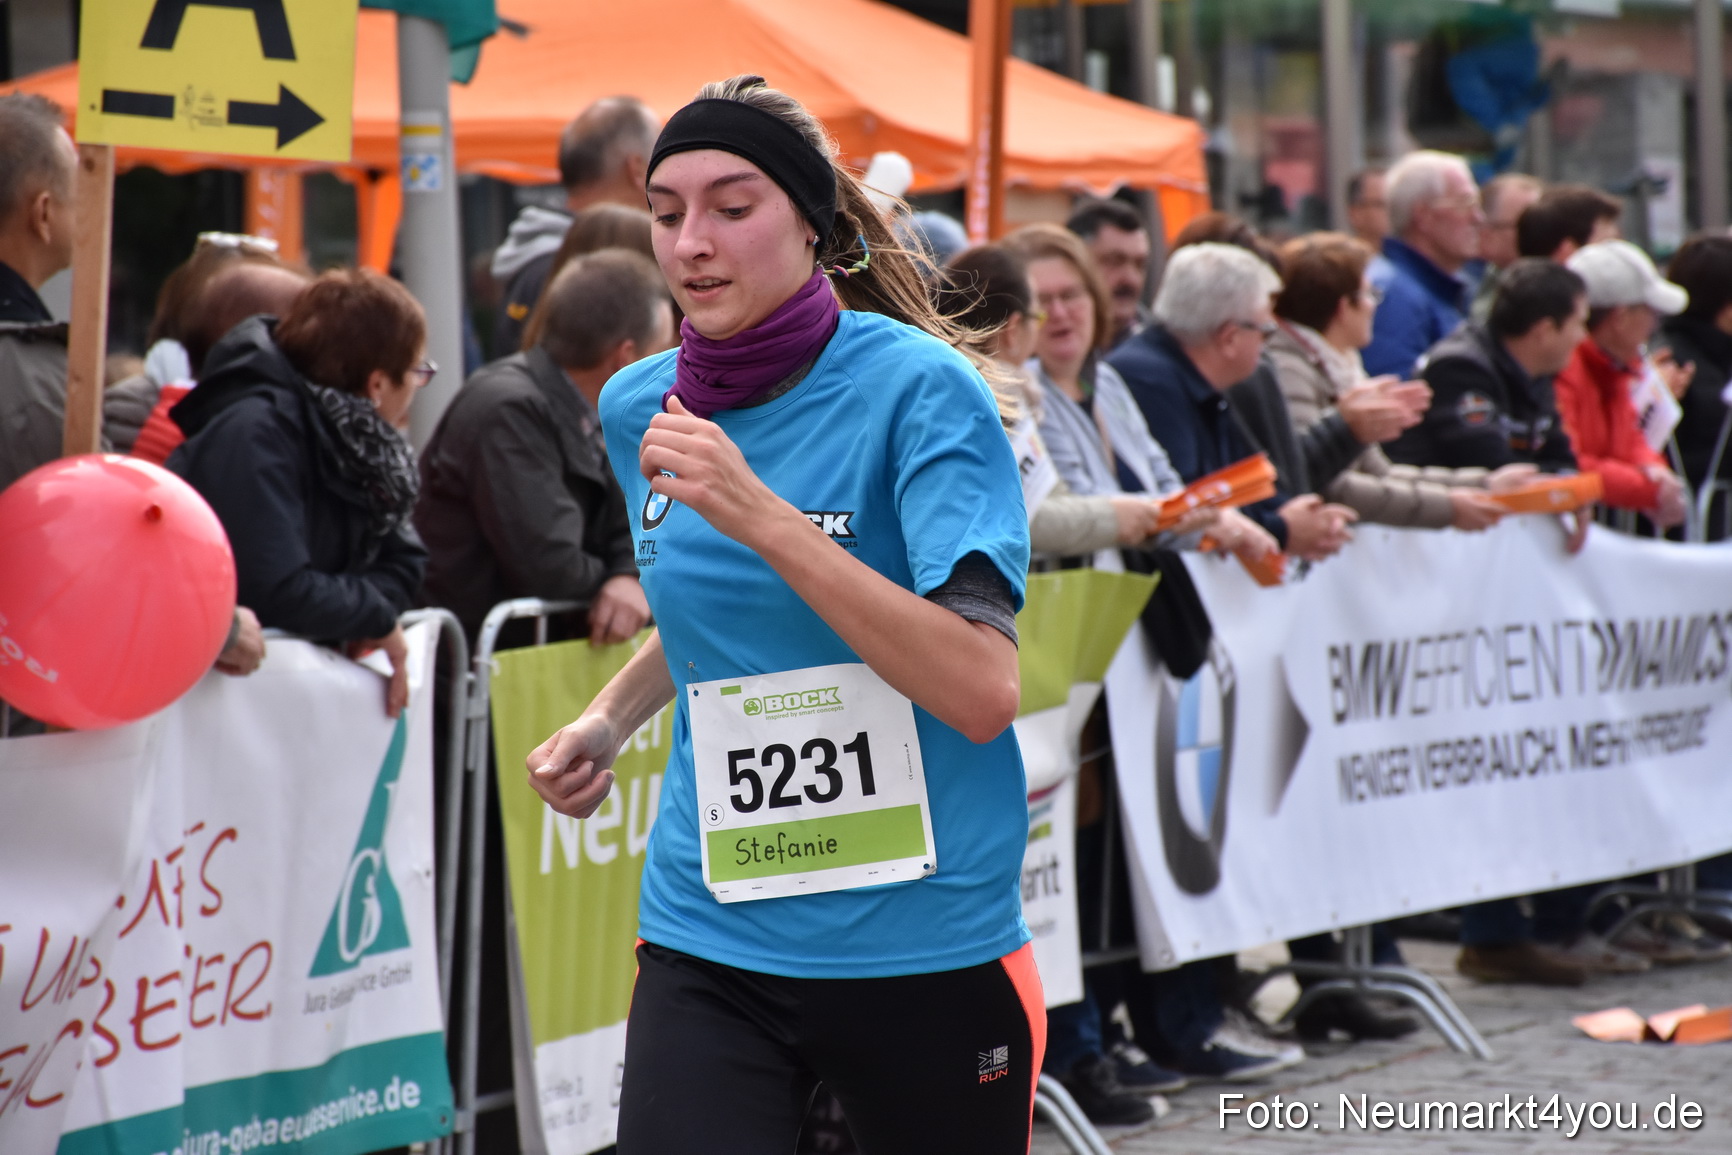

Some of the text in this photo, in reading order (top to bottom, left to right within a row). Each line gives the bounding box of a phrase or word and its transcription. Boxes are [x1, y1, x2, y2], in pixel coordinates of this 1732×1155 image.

[764, 687, 842, 714] BOCK
[765, 712, 789, 721] inspired
[798, 709, 815, 717] smart
[816, 705, 844, 714] concepts
[728, 731, 876, 814] 5231
[710, 808, 719, 821] S
[735, 832, 838, 865] Stefanie
[979, 1067, 1008, 1084] RUN
